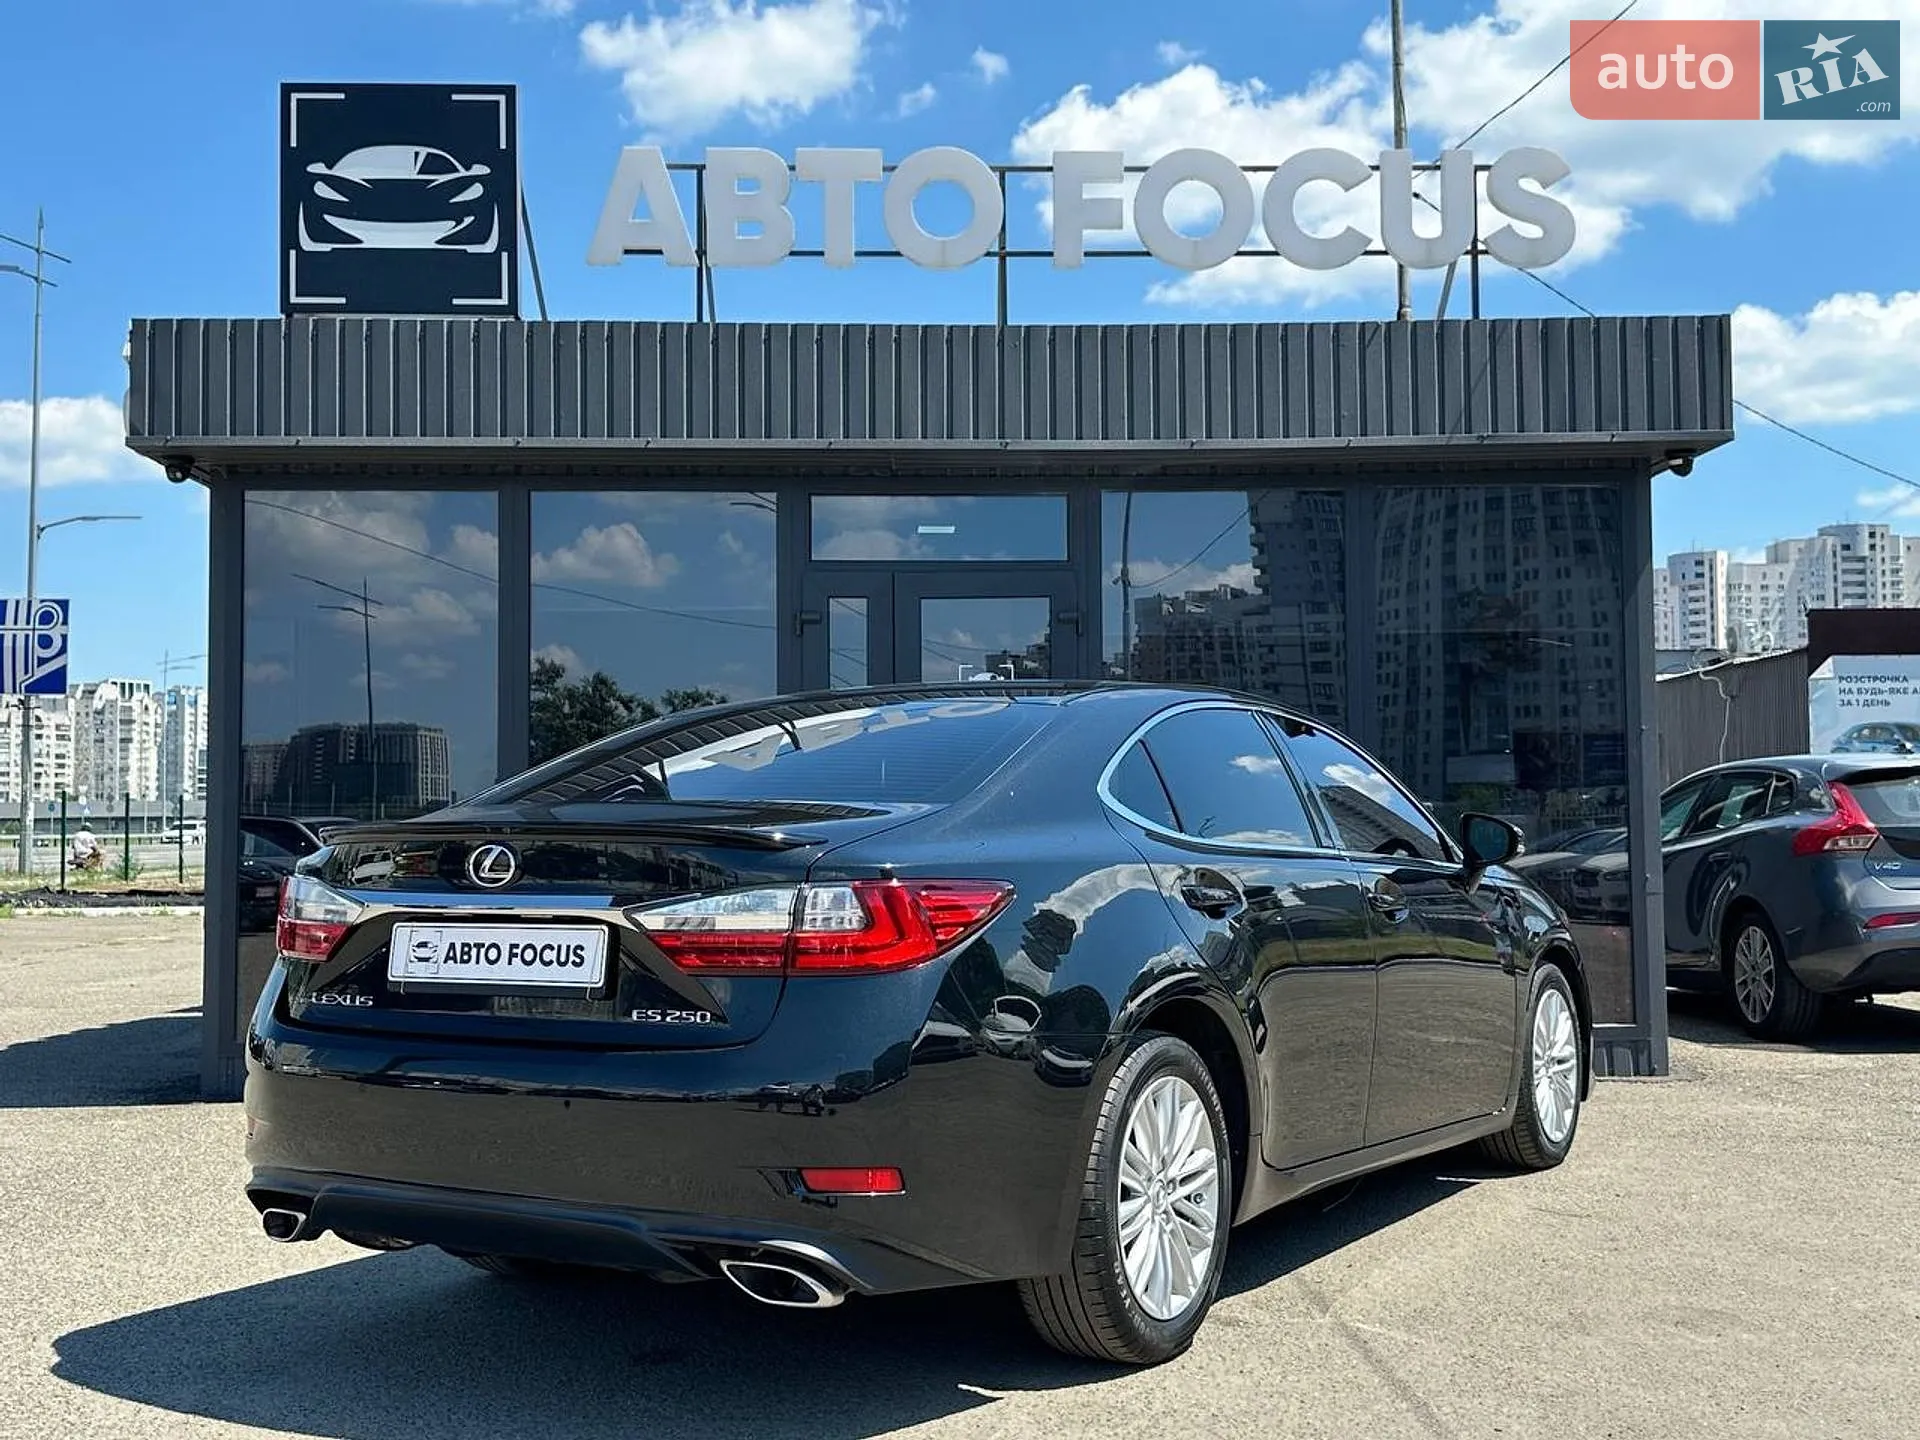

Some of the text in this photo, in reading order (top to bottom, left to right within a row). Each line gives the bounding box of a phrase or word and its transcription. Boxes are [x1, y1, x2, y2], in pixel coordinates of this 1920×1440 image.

[586, 146, 1577, 270] АВТО FOCUS
[1838, 674, 1909, 684] РОЗСТРОЧКА
[1838, 687, 1854, 696] НА
[1857, 687, 1909, 696] БУДЬ-ЯКЕ
[1839, 699, 1853, 707] ЗА
[1862, 699, 1892, 708] ДЕНЬ
[443, 942, 585, 968] АВТО FOCUS
[310, 992, 374, 1007] LEXUS
[632, 1009, 711, 1023] ES 250
